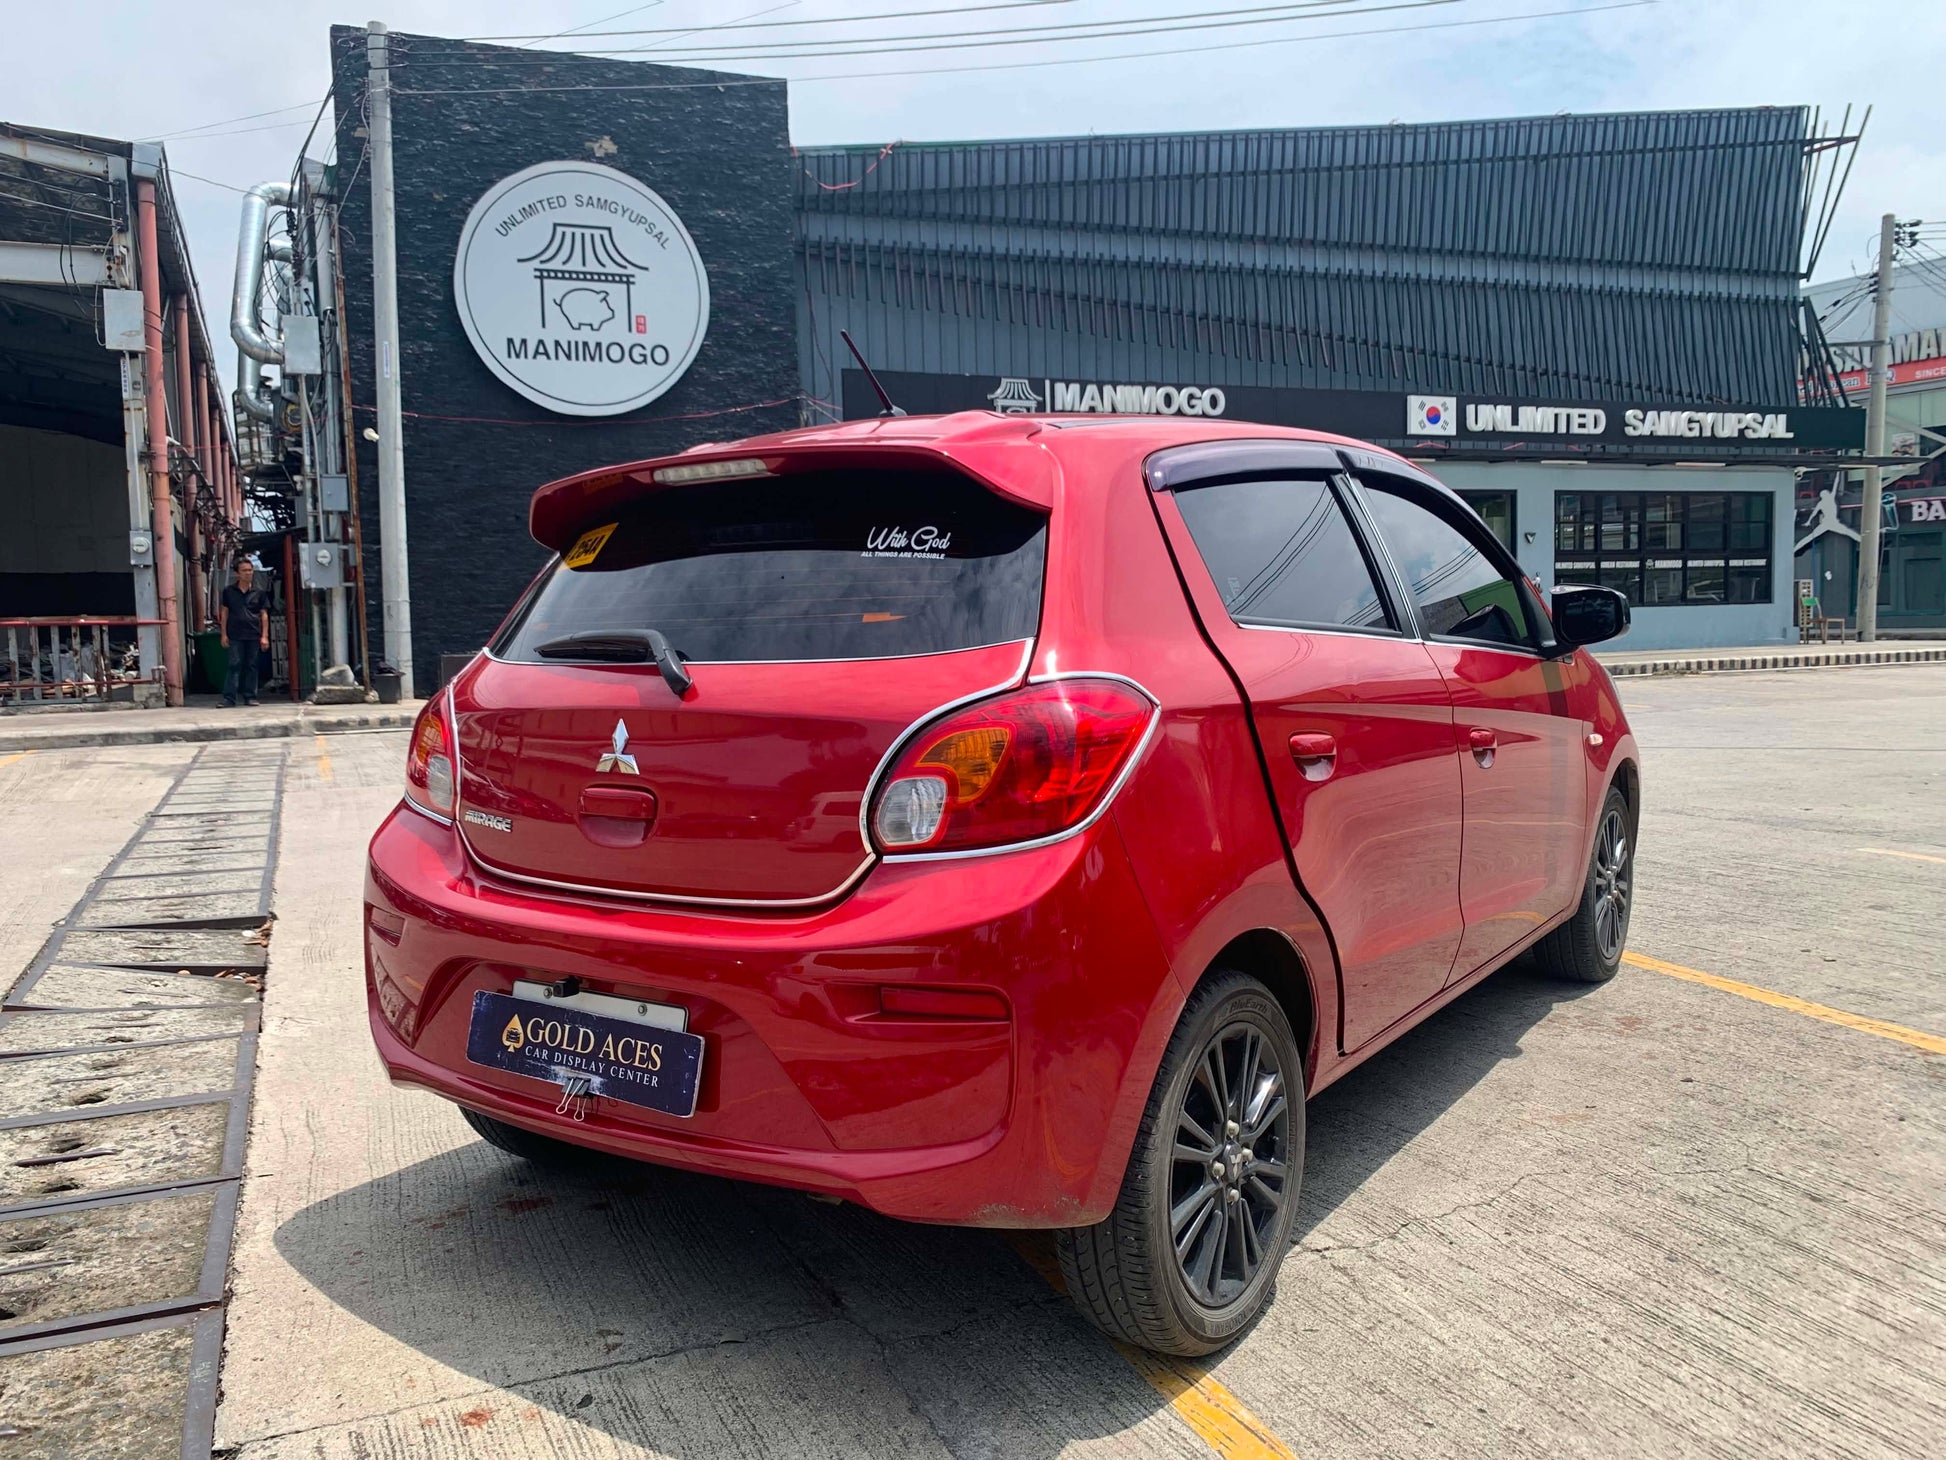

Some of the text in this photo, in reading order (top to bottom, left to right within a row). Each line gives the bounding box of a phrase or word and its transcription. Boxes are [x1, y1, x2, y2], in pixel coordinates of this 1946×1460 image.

[495, 194, 670, 250] UNLIMITED SAMGYUPSAL
[506, 337, 669, 366] MANIMOGO
[1054, 382, 1226, 416] MANIMOGO
[1466, 403, 1794, 439] UNLIMITED SAMGYUPSAL
[867, 526, 951, 551] With God
[913, 552, 945, 560] POSSIBLE
[465, 810, 512, 832] MIRAGE
[526, 1017, 662, 1071] GOLD ACES
[525, 1045, 659, 1087] CAR DISPLAY CENTER
